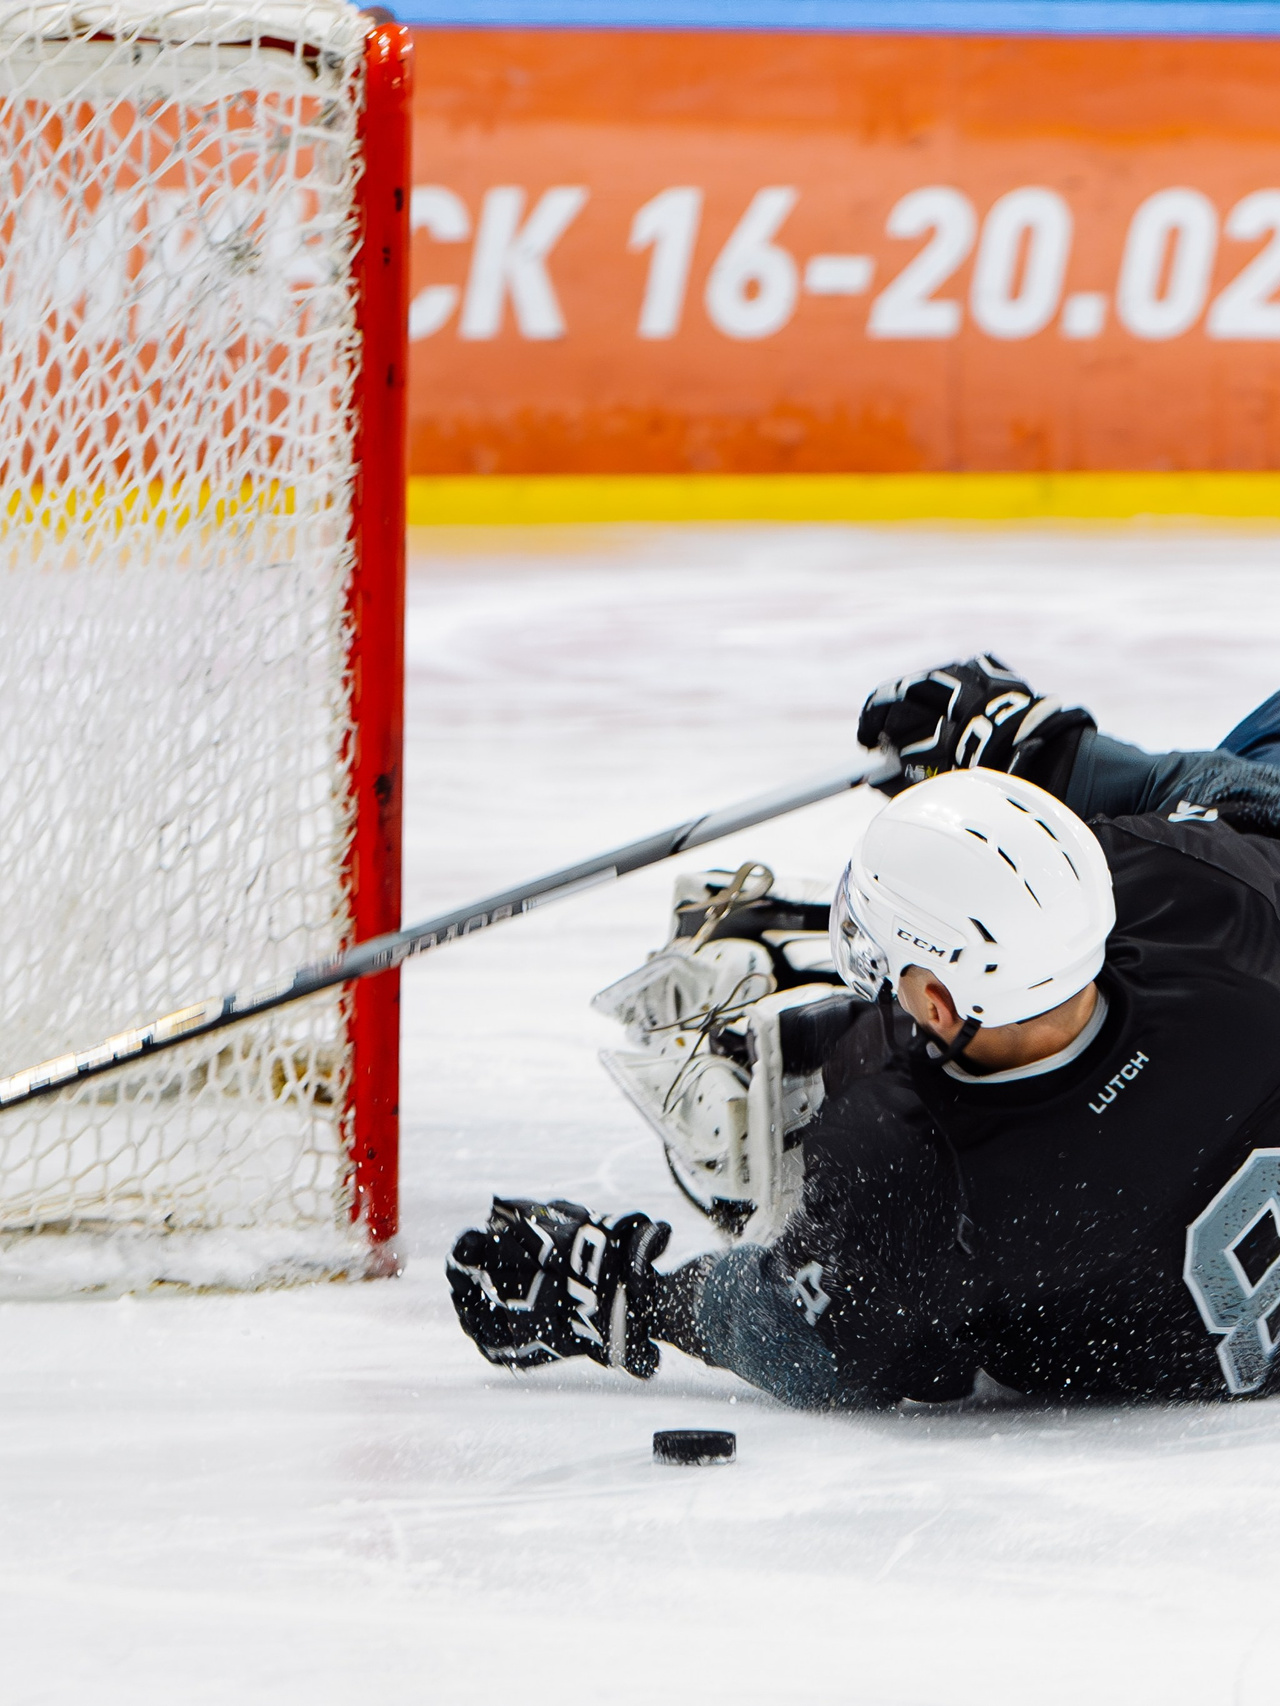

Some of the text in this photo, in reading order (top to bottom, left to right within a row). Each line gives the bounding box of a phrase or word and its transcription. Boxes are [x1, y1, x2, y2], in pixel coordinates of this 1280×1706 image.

[953, 691, 1031, 770] CC
[897, 927, 946, 957] CCM
[1088, 1050, 1150, 1114] LUTCH
